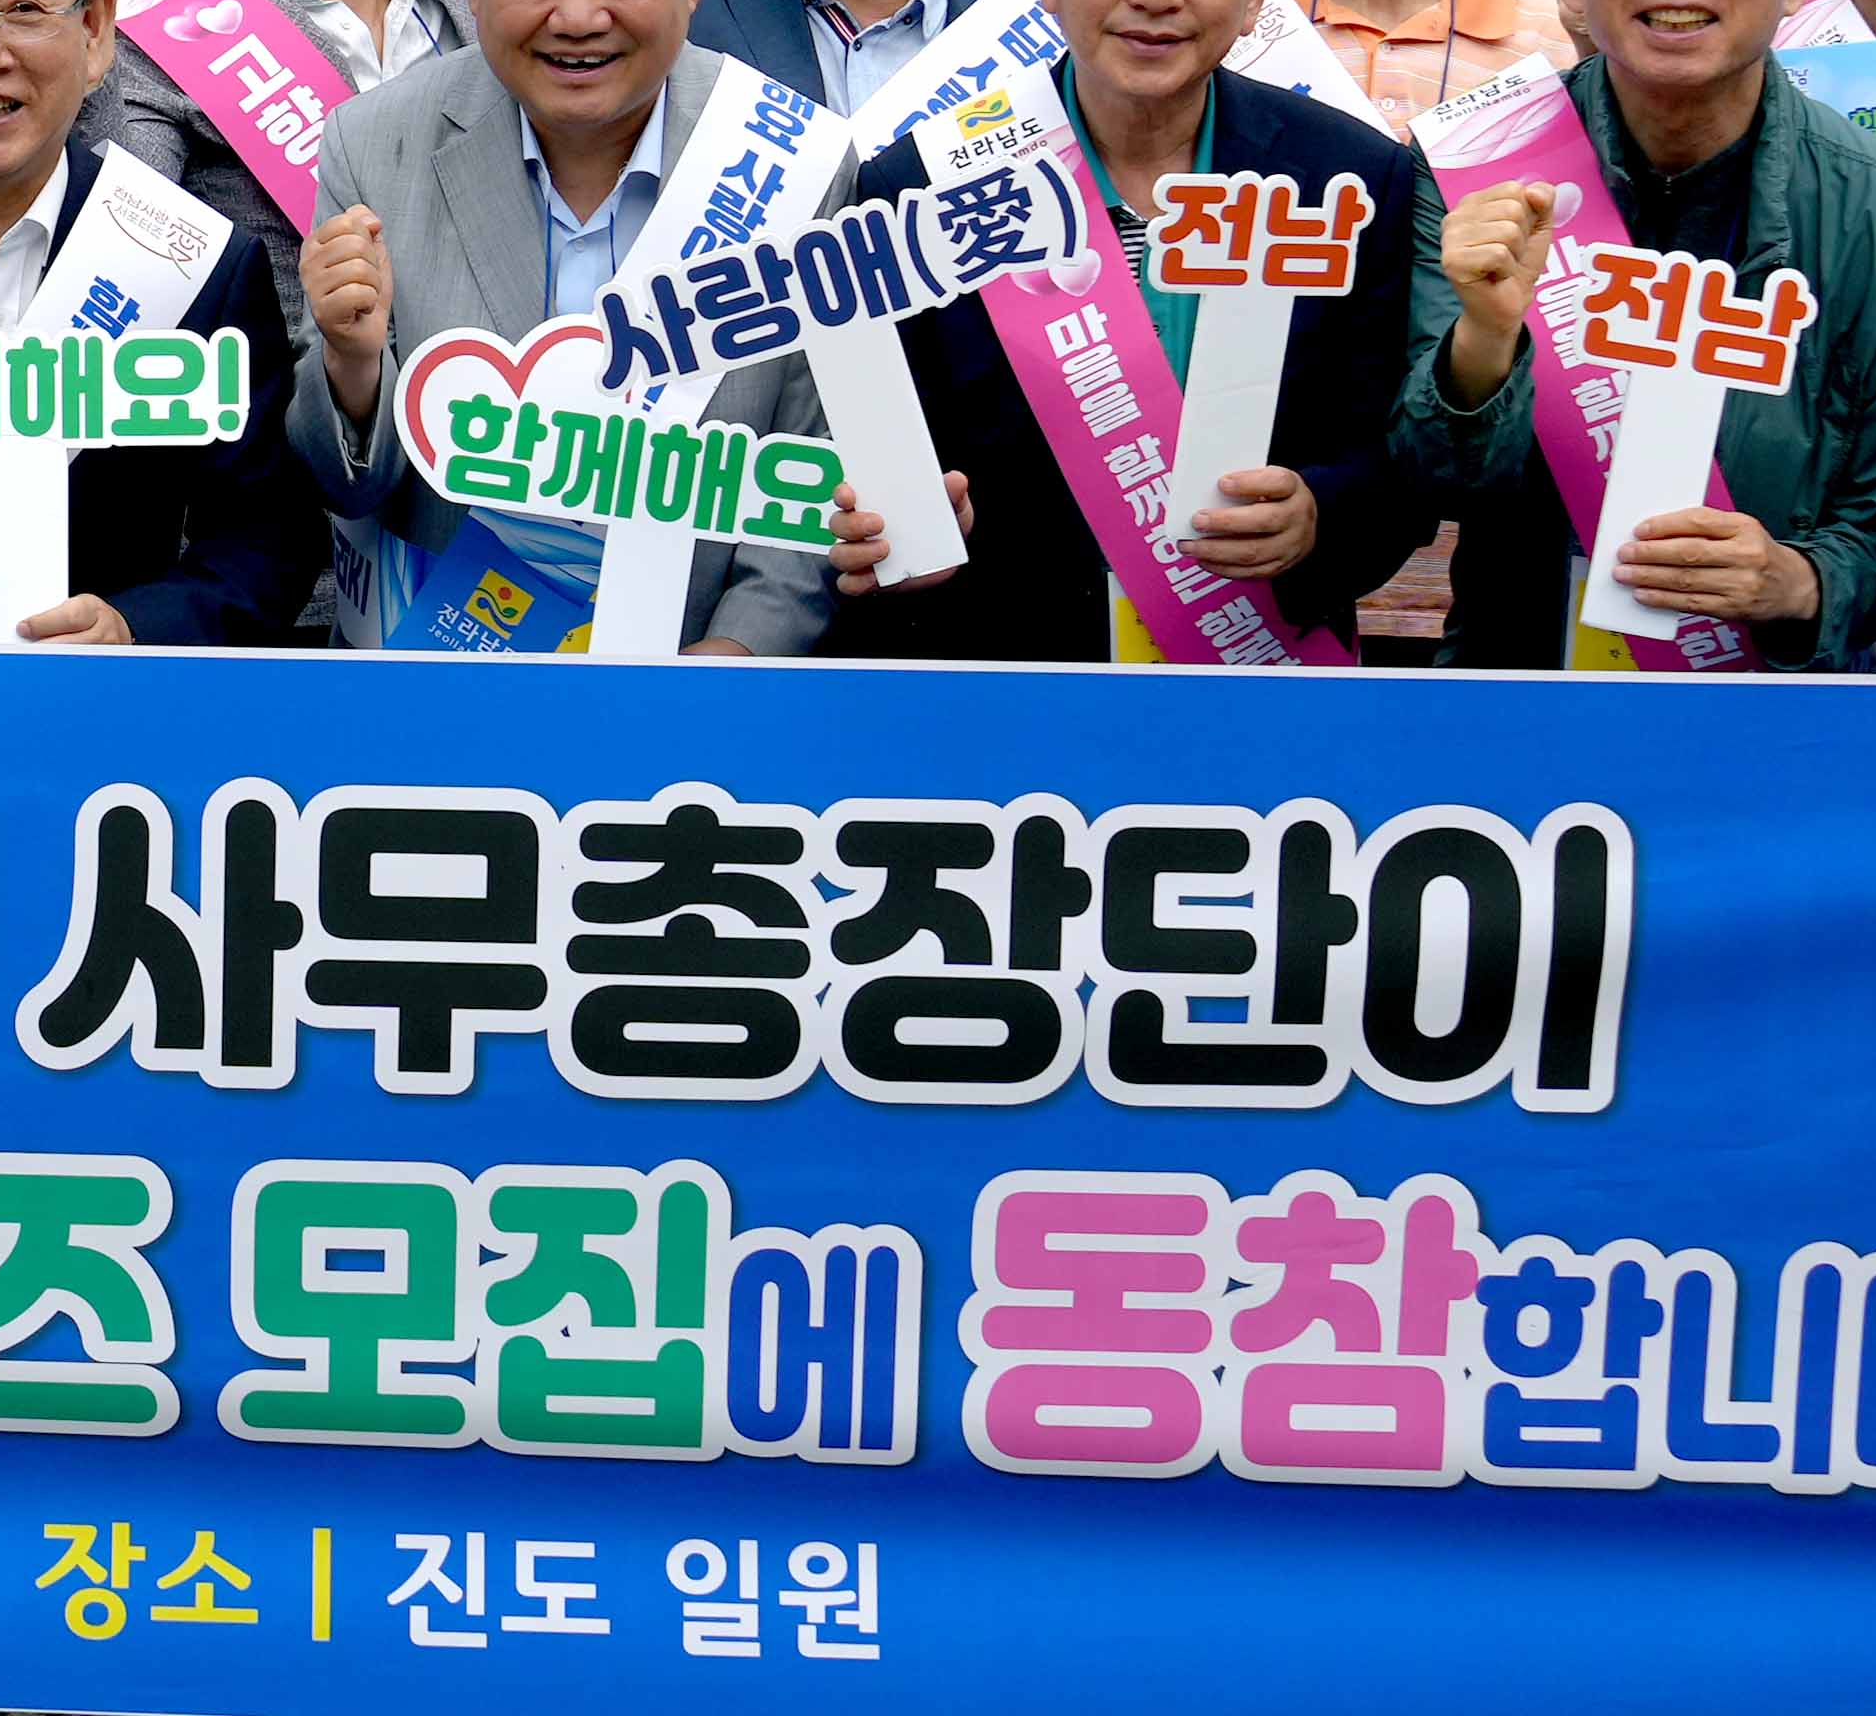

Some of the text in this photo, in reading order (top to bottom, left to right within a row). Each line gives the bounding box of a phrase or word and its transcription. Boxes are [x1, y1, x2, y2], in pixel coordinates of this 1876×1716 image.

[948, 117, 1044, 169] 전라남도
[601, 162, 1078, 388] 사랑애(愛)
[1159, 181, 1366, 286] 전남
[1044, 303, 1142, 438] 마음을
[1584, 253, 1807, 386] 전남
[448, 395, 842, 544] 함께해요
[37, 801, 1603, 1094] 사무총장단이
[246, 1176, 904, 1455] 모집에
[37, 1523, 256, 1641] 장소
[387, 1533, 607, 1647] 진도
[666, 1539, 881, 1660] 일원
